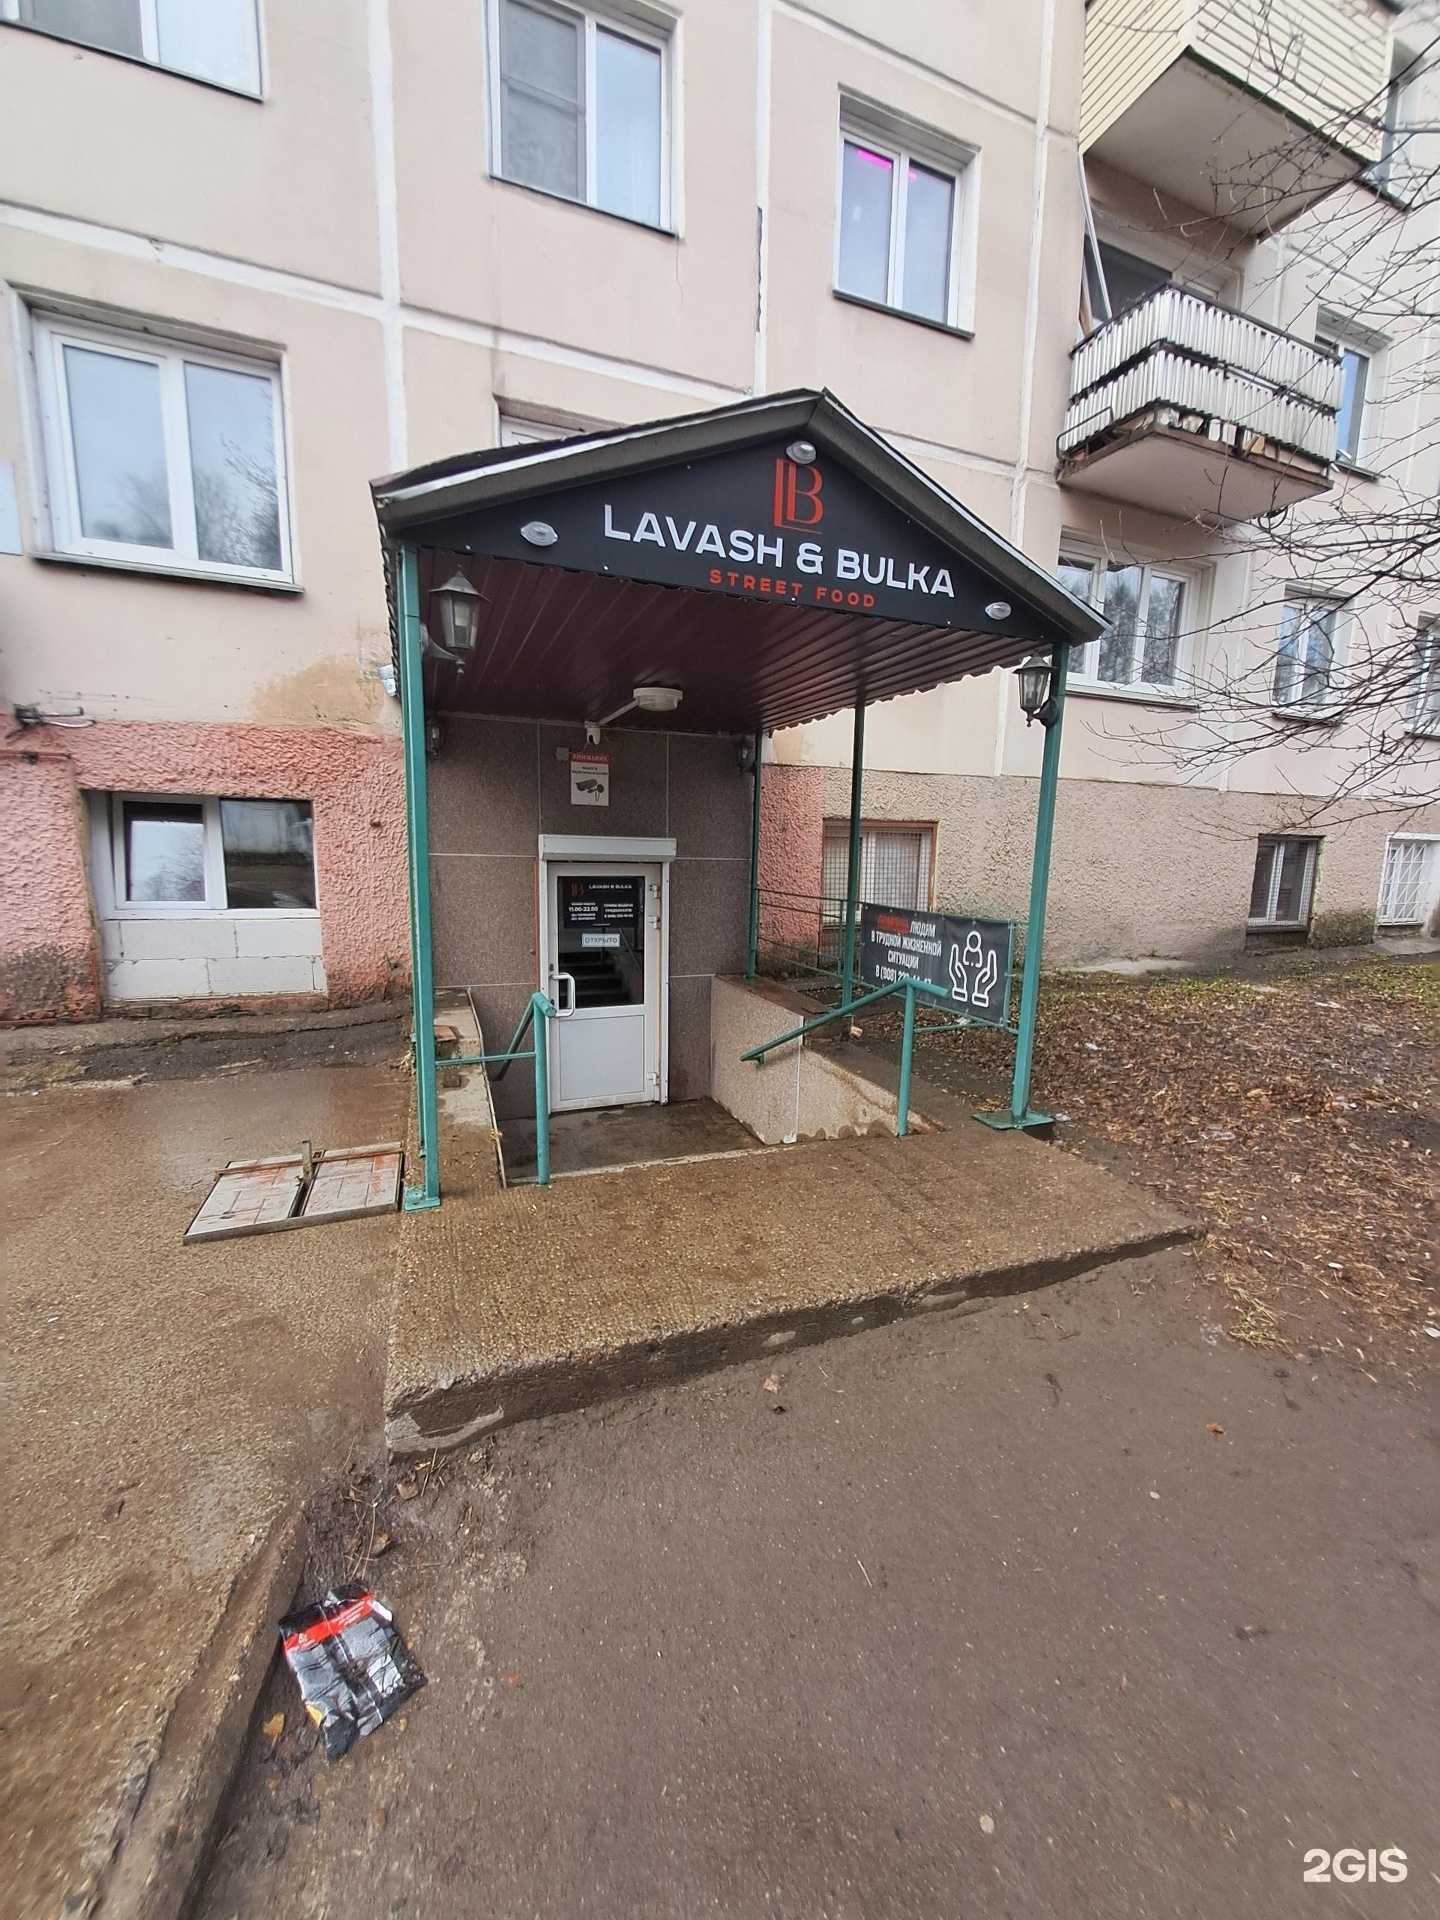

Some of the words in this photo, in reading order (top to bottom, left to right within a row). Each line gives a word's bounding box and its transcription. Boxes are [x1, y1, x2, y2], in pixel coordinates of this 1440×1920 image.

[604, 503, 784, 568] LAVASH
[796, 542, 824, 575] &
[836, 548, 956, 598] BULKA
[708, 568, 803, 598] STREET
[815, 586, 876, 608] FOOD
[910, 920, 936, 938] ЛЮДЯМ
[876, 931, 901, 947] ТРУДНОЙ
[902, 936, 942, 957] ЖИЗНЕННОЙ
[888, 950, 919, 969] СИТУАЦИИ
